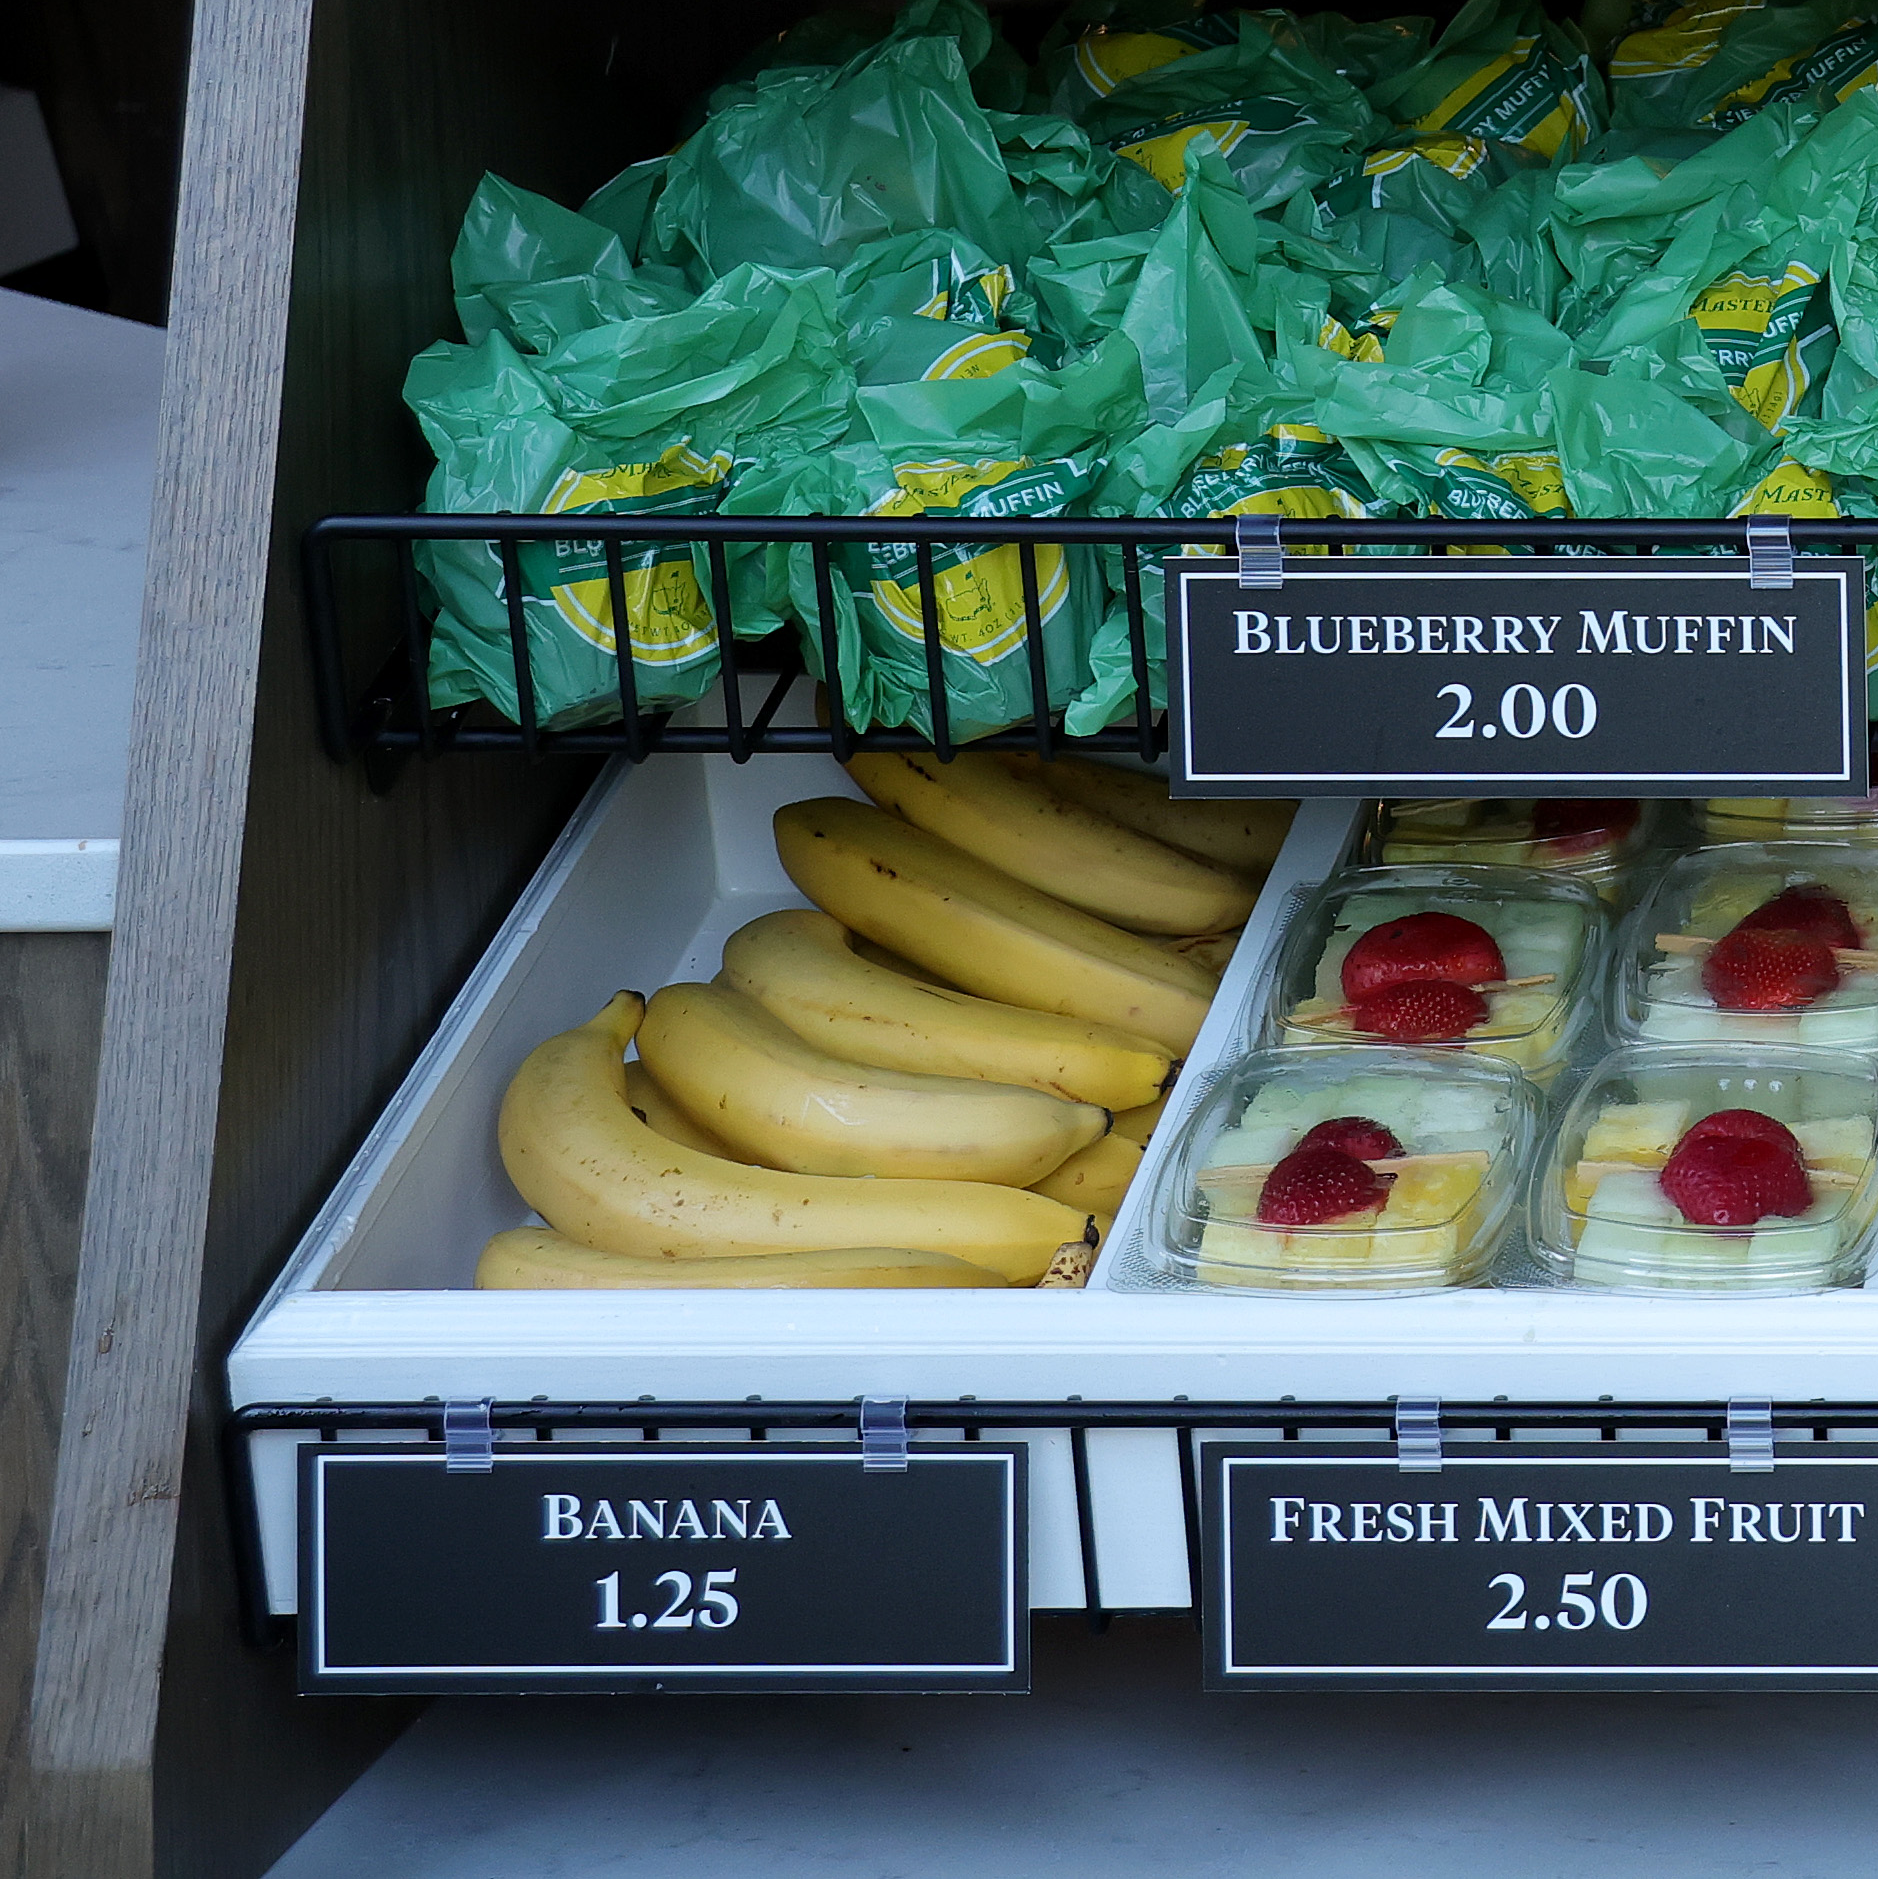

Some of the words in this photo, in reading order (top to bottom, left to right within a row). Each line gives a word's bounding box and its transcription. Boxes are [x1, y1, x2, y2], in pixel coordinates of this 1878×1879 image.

[1233, 612, 1561, 653] BLUEBERRY
[1577, 611, 1796, 655] MUFFIN
[1436, 684, 1596, 738] 2.00
[544, 1495, 791, 1538] BANANA
[1270, 1498, 1458, 1542] FRESH
[1475, 1498, 1672, 1541] MIXED
[1690, 1498, 1864, 1542] FRUIT
[597, 1568, 737, 1627] 1.25
[1487, 1571, 1647, 1629] 2.50
